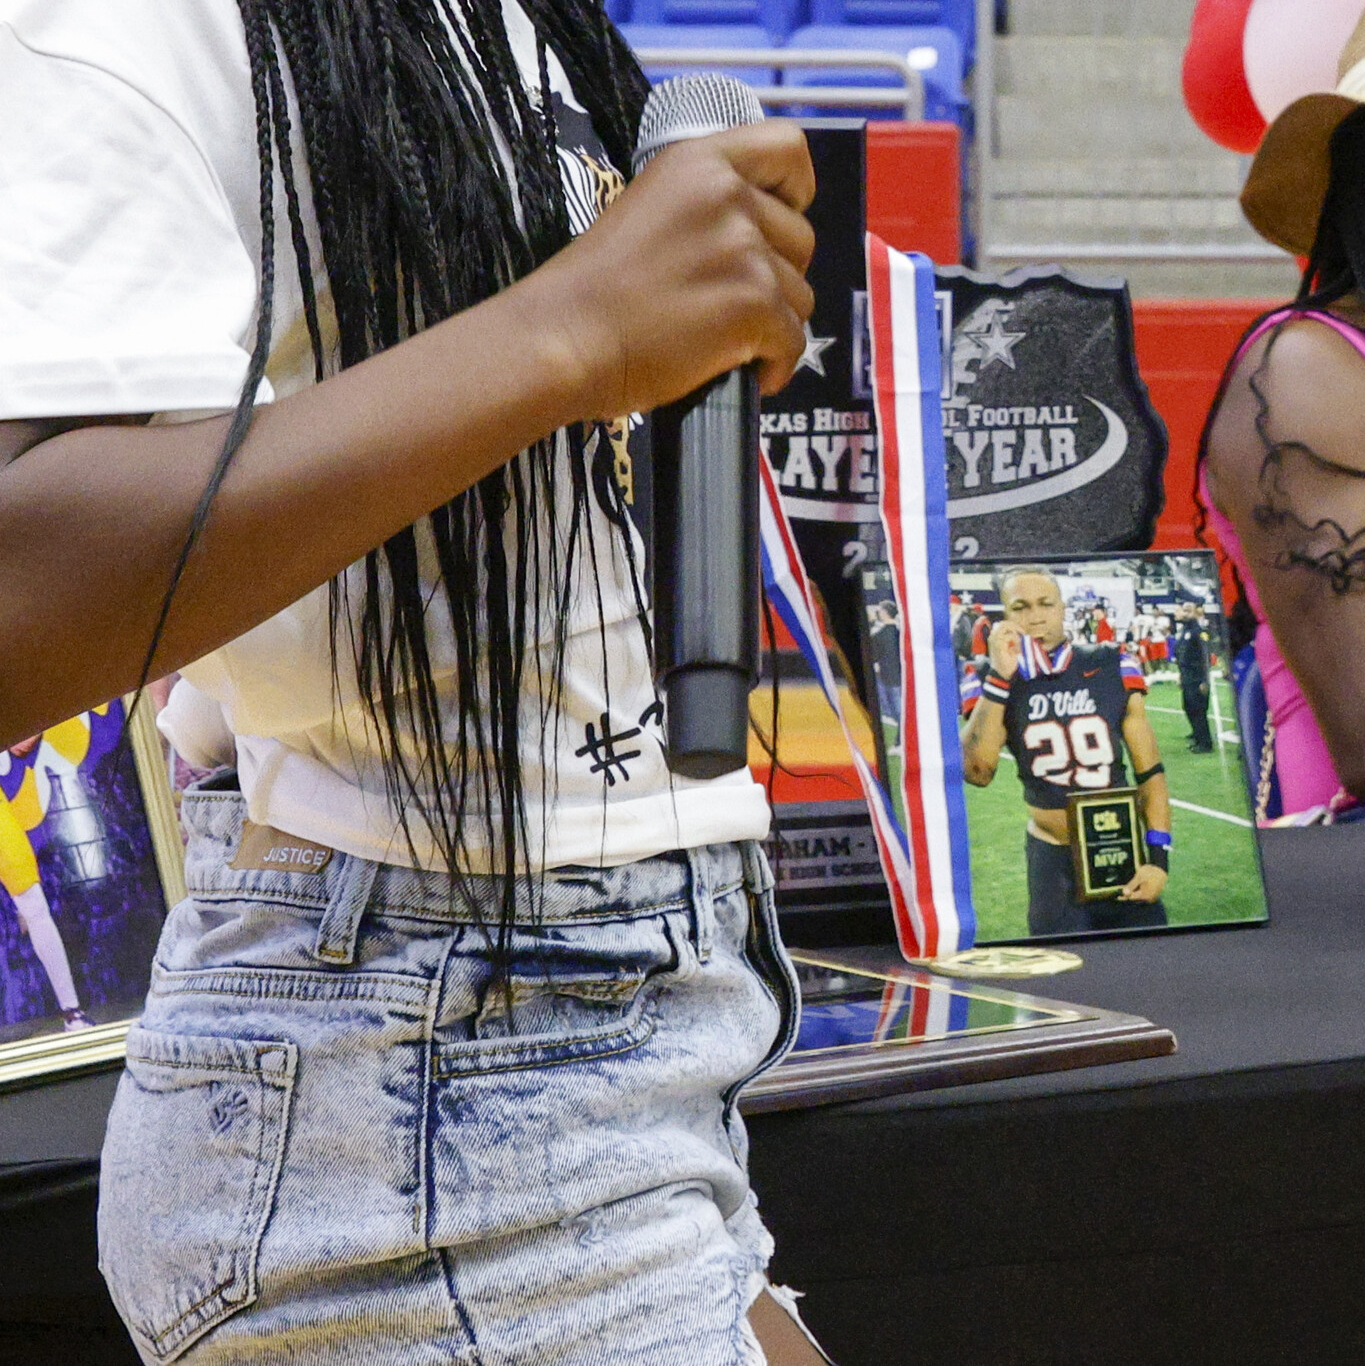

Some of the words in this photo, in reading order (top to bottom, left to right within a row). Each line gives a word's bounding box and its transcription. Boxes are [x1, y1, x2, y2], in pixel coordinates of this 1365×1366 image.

[967, 404, 1079, 427] FOOTBALL
[953, 425, 1077, 489] YEAR
[1028, 688, 1097, 721] D'Ville
[1023, 715, 1114, 788] 29
[263, 846, 326, 866] JUSTICE
